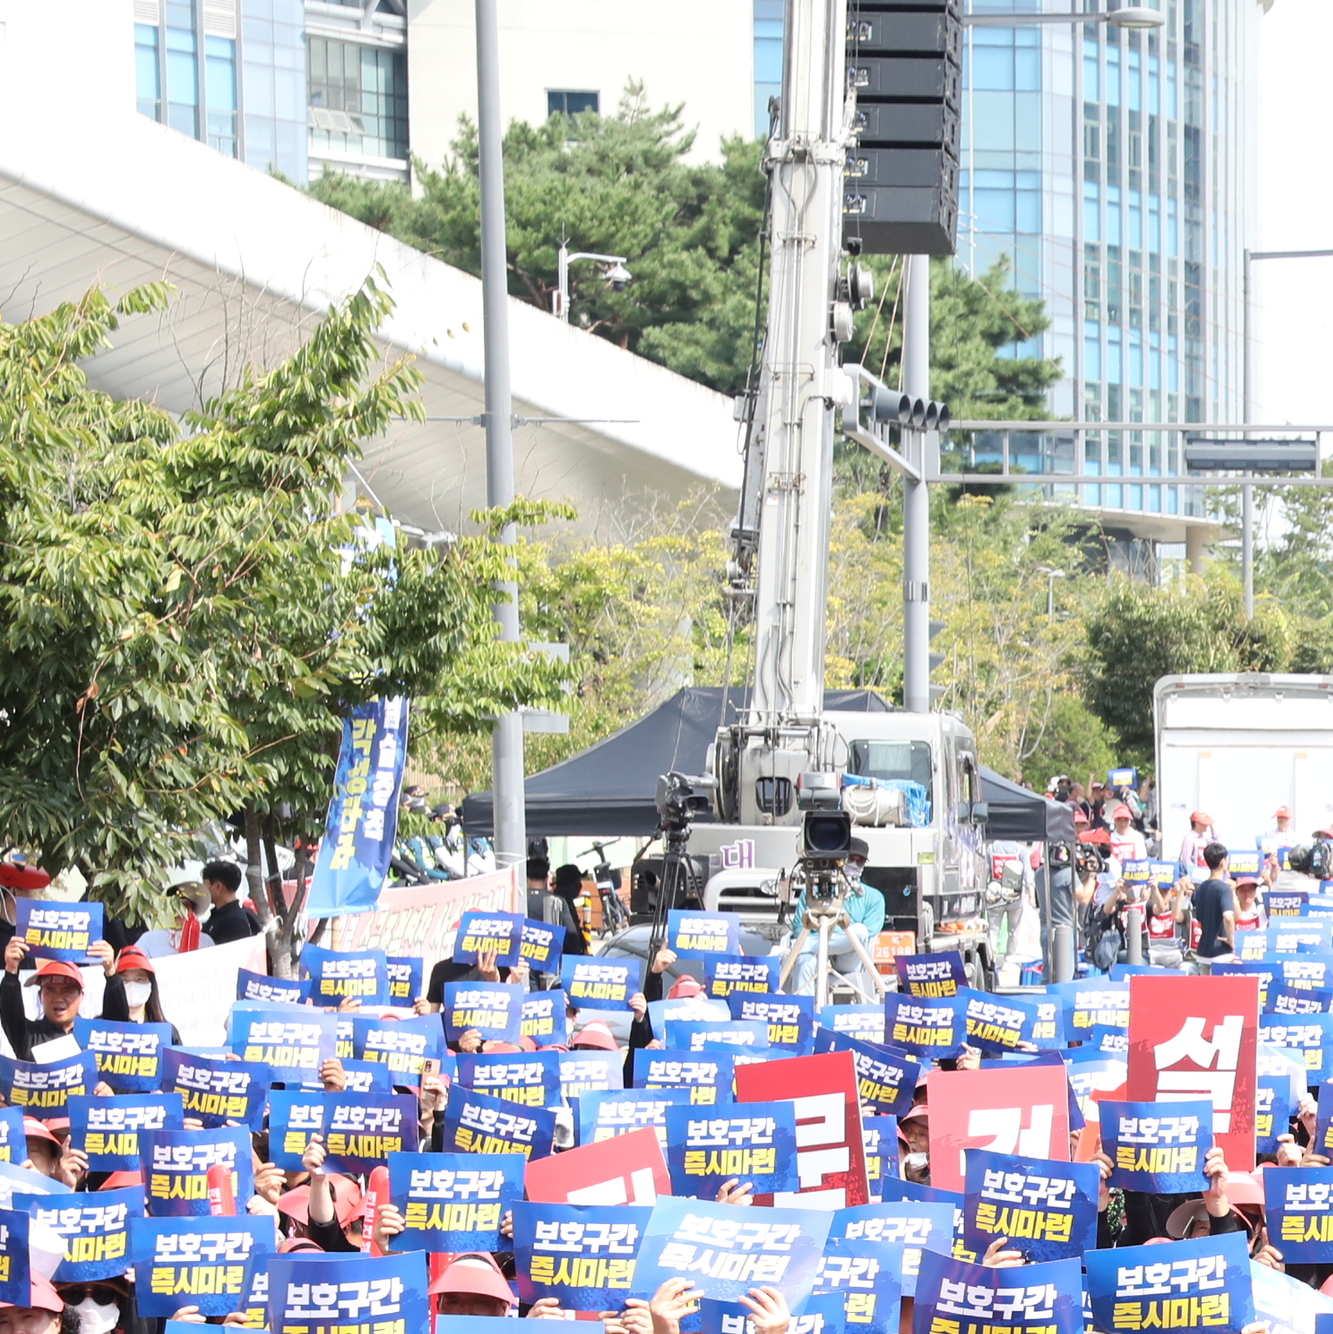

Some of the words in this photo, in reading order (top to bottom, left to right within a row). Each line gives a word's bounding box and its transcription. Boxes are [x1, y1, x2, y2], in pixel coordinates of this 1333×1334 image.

[330, 719, 377, 870] 각성하라
[721, 839, 755, 870] 대
[29, 910, 90, 930] 보호구간
[679, 918, 729, 935] 보호구간
[24, 929, 88, 949] 즉시마련
[675, 934, 728, 951] 즉시마련
[174, 1064, 250, 1096] 보호구간
[175, 1087, 247, 1117] 즉시마련
[331, 1106, 401, 1132] 보호구간
[687, 1118, 775, 1146] 보호구간
[1118, 1116, 1199, 1143] 보호구간
[328, 1134, 401, 1158] 즉시마련
[1117, 1147, 1194, 1172] 즉시마련
[685, 1149, 775, 1175] 즉시마련
[407, 1169, 504, 1200] 보호구간
[405, 1200, 502, 1232] 즉시마련
[534, 1221, 638, 1253] 보호구간
[531, 1256, 633, 1288] 즉시마련
[1117, 1255, 1229, 1298] 보호구간
[286, 1278, 403, 1318] 보호구간
[937, 1279, 1057, 1319] 보호구간
[1114, 1296, 1228, 1329] 즉시마련
